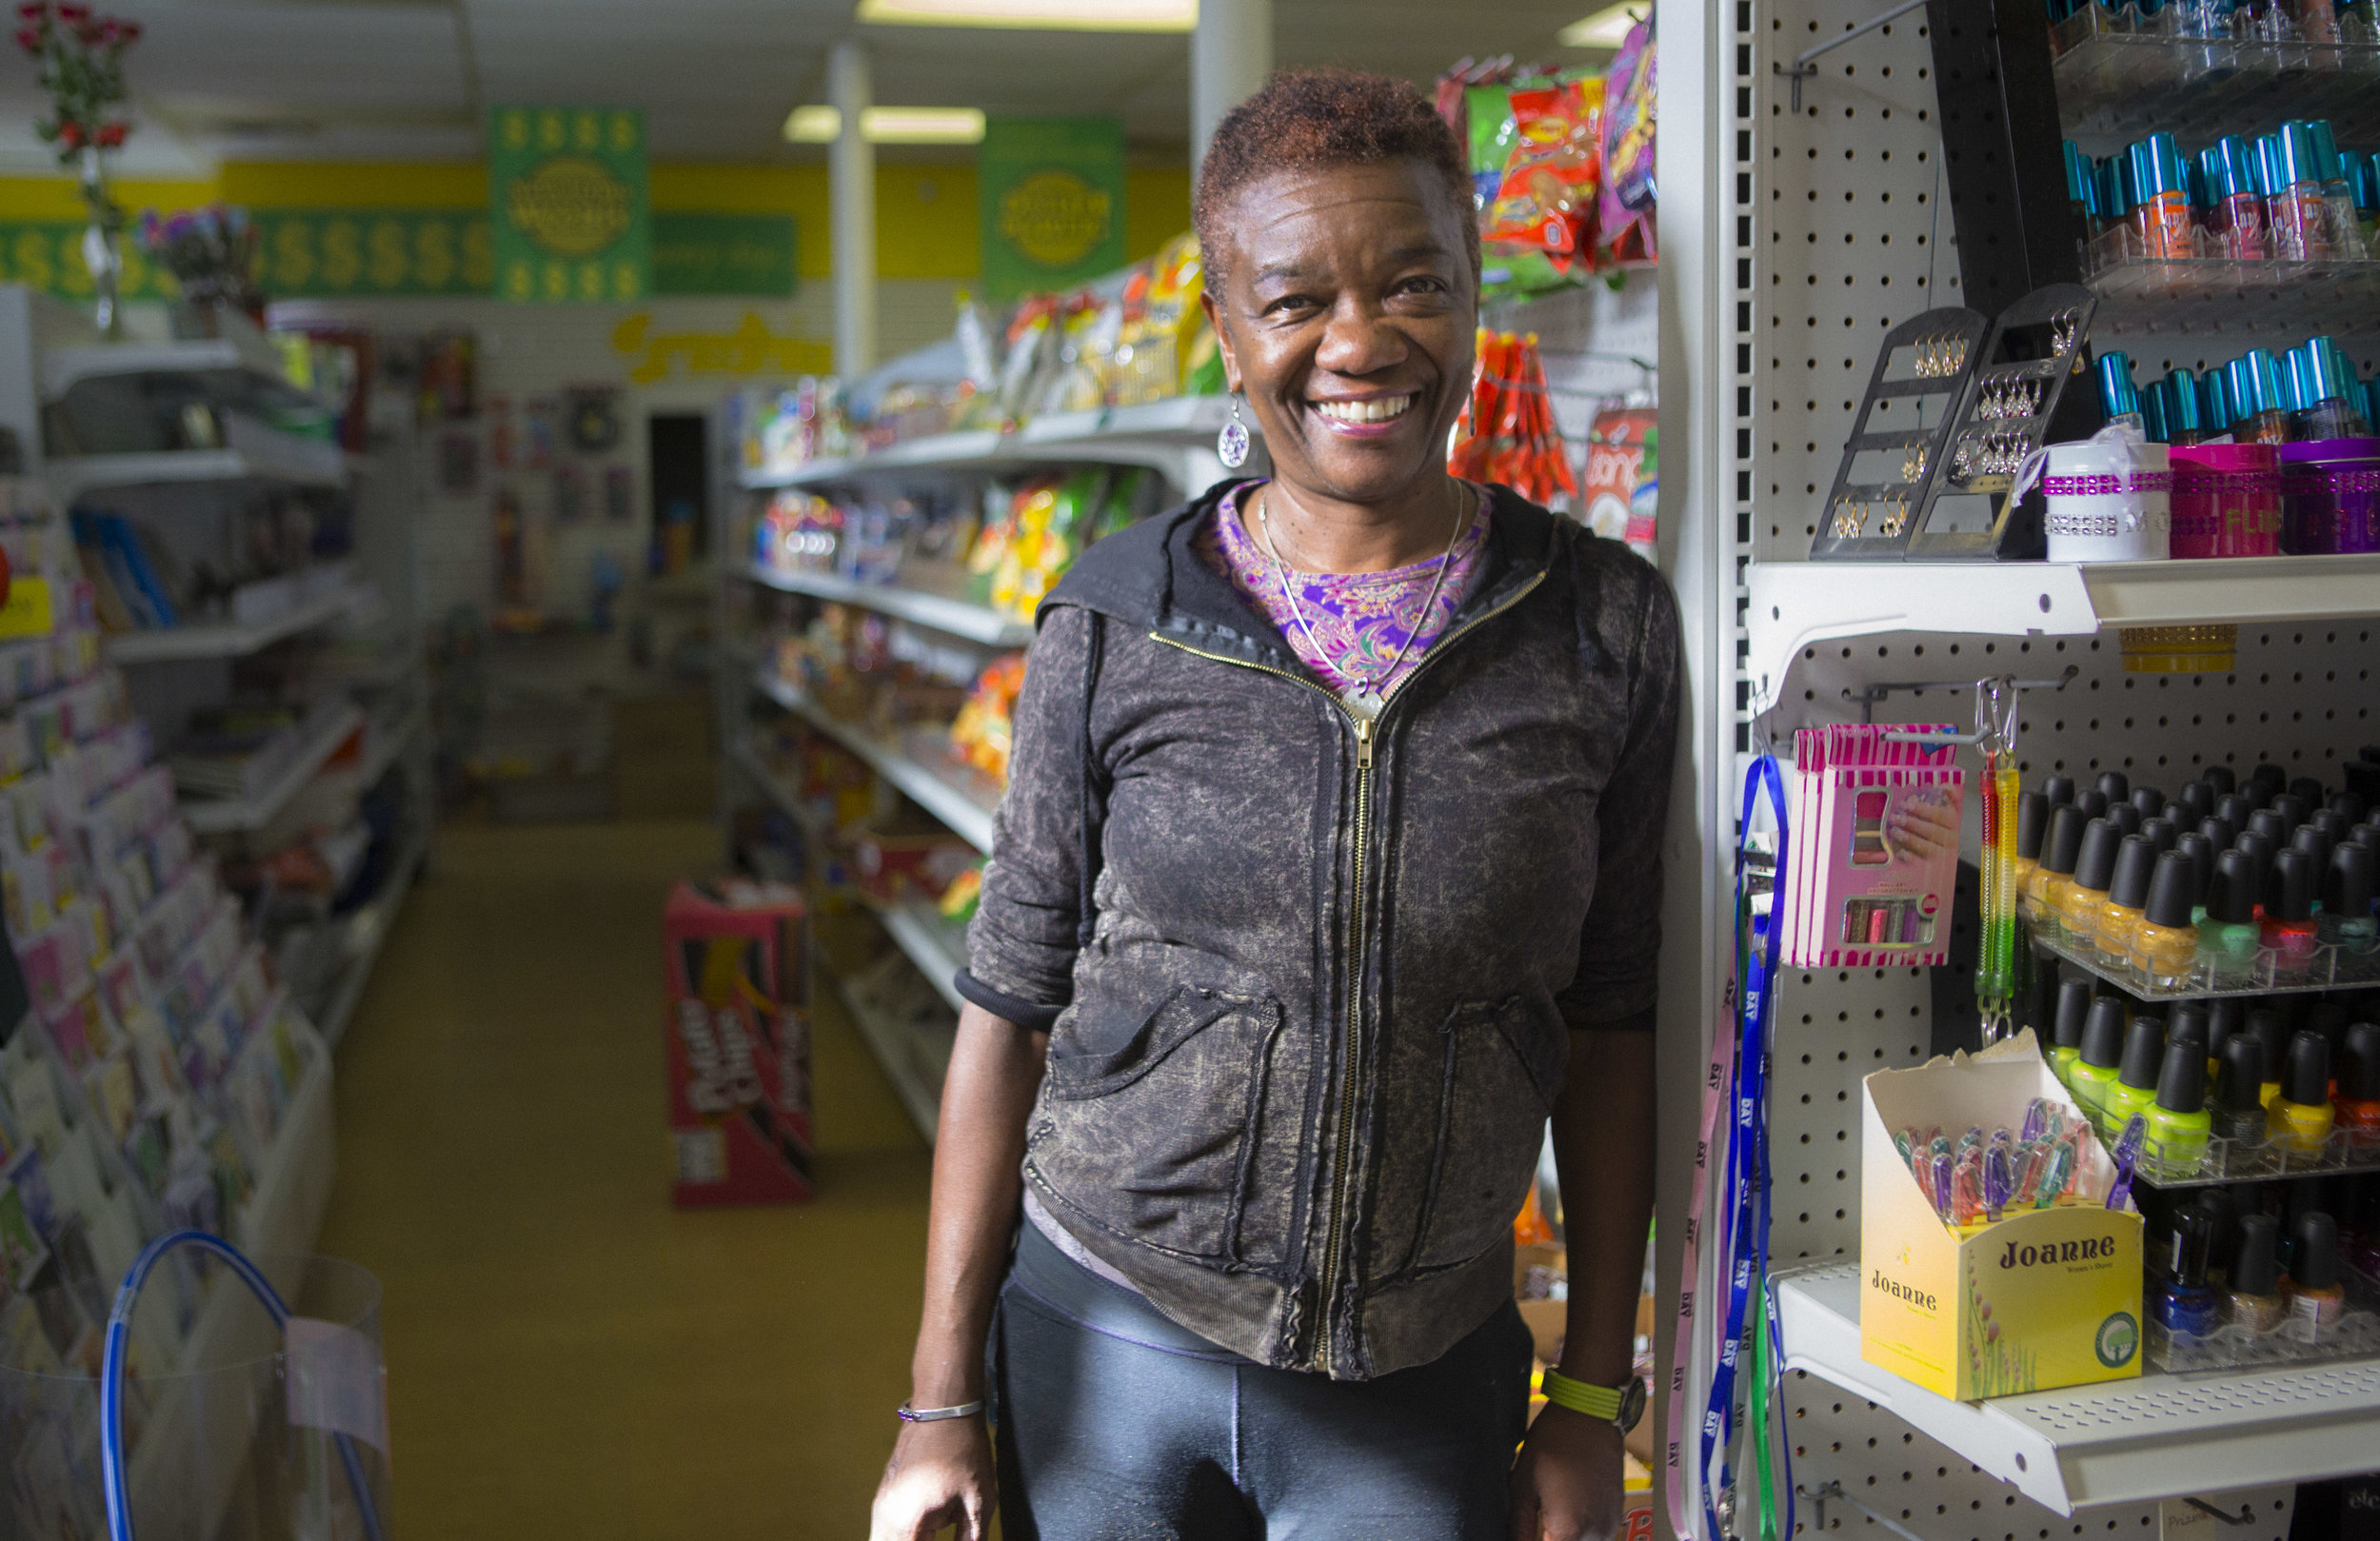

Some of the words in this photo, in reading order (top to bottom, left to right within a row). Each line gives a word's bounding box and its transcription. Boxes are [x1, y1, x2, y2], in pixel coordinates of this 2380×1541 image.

[1740, 1097, 1752, 1128] DAY
[1999, 1235, 2115, 1269] Joanne
[1872, 1269, 1937, 1312] Joanne
[1702, 1410, 1717, 1438] DAY
